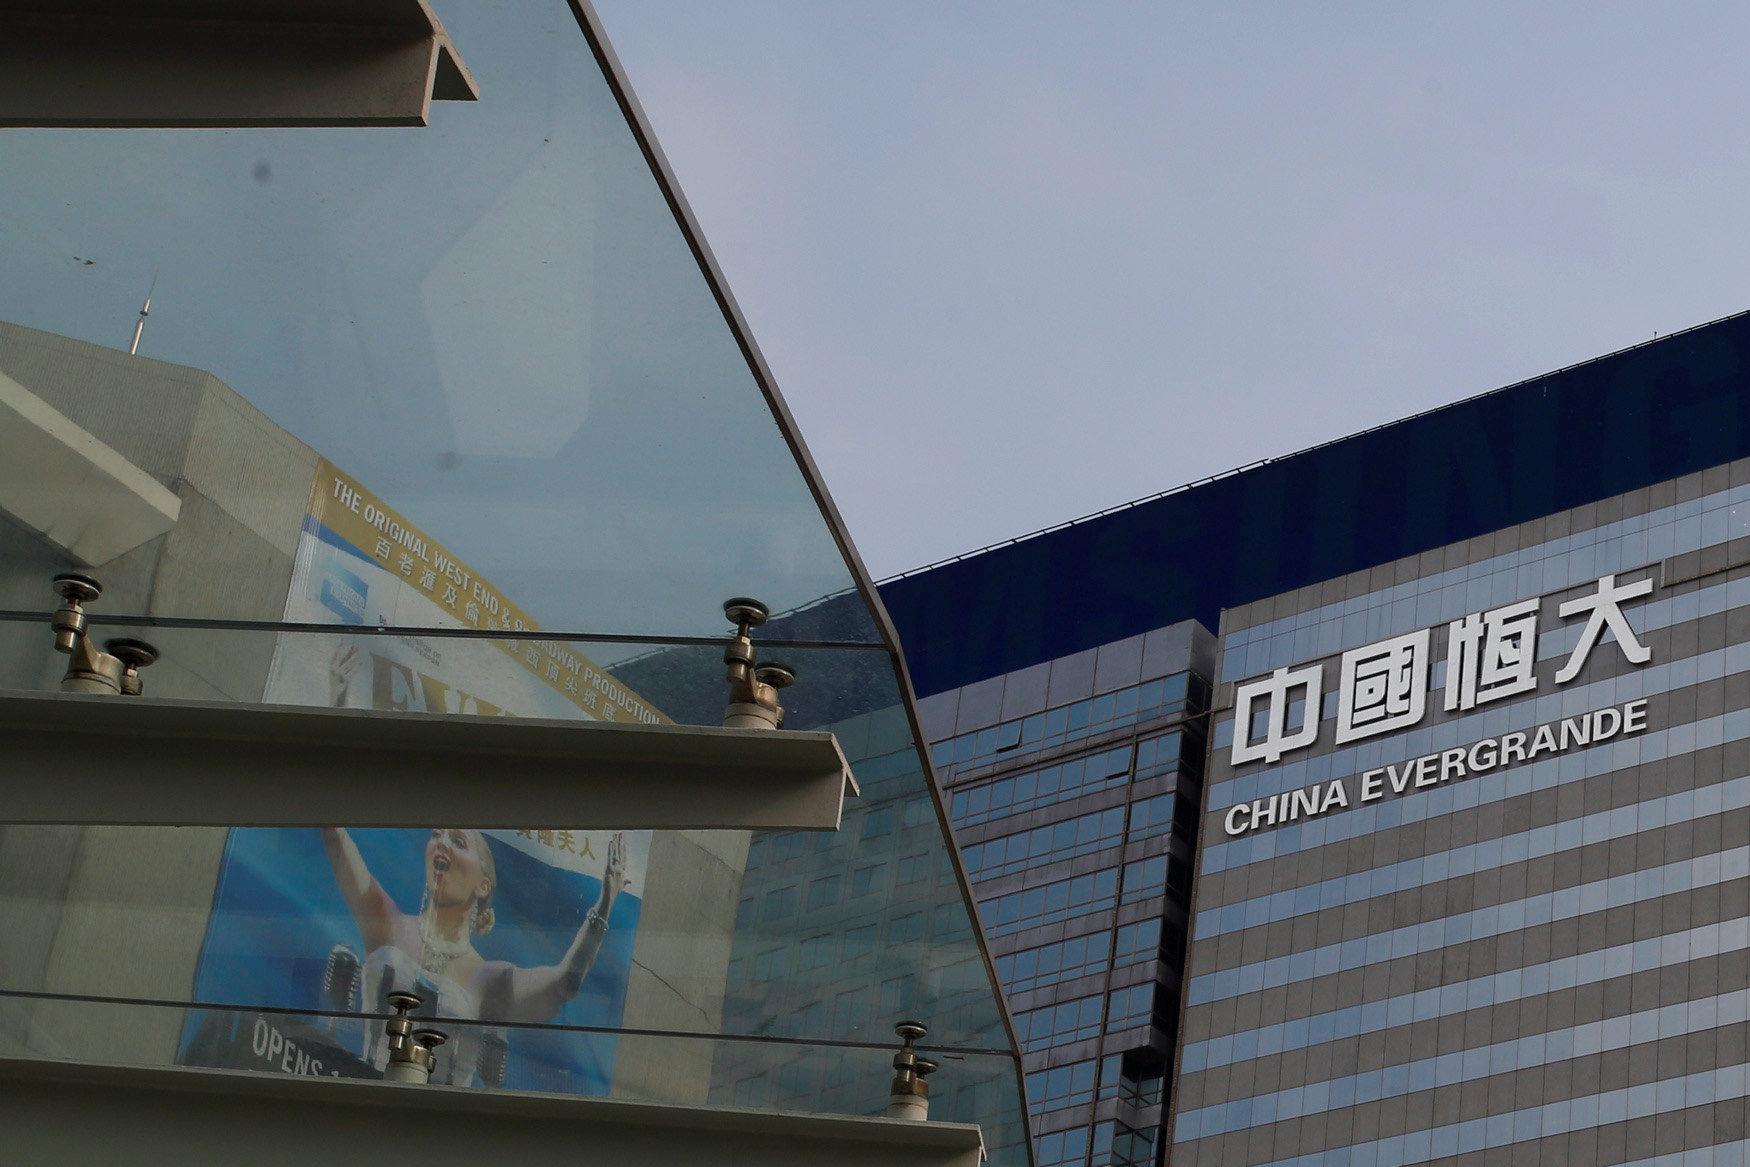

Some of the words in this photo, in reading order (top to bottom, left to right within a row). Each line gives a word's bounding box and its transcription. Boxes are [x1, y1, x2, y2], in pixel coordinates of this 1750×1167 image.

[333, 477, 362, 514] THE
[364, 504, 430, 562] ORIGINAL
[434, 550, 471, 590] WEST
[473, 580, 499, 615] END
[1224, 777, 1348, 836] CHINA
[1360, 699, 1648, 802] EVERGRANDE
[252, 1018, 323, 1077] OPENS
